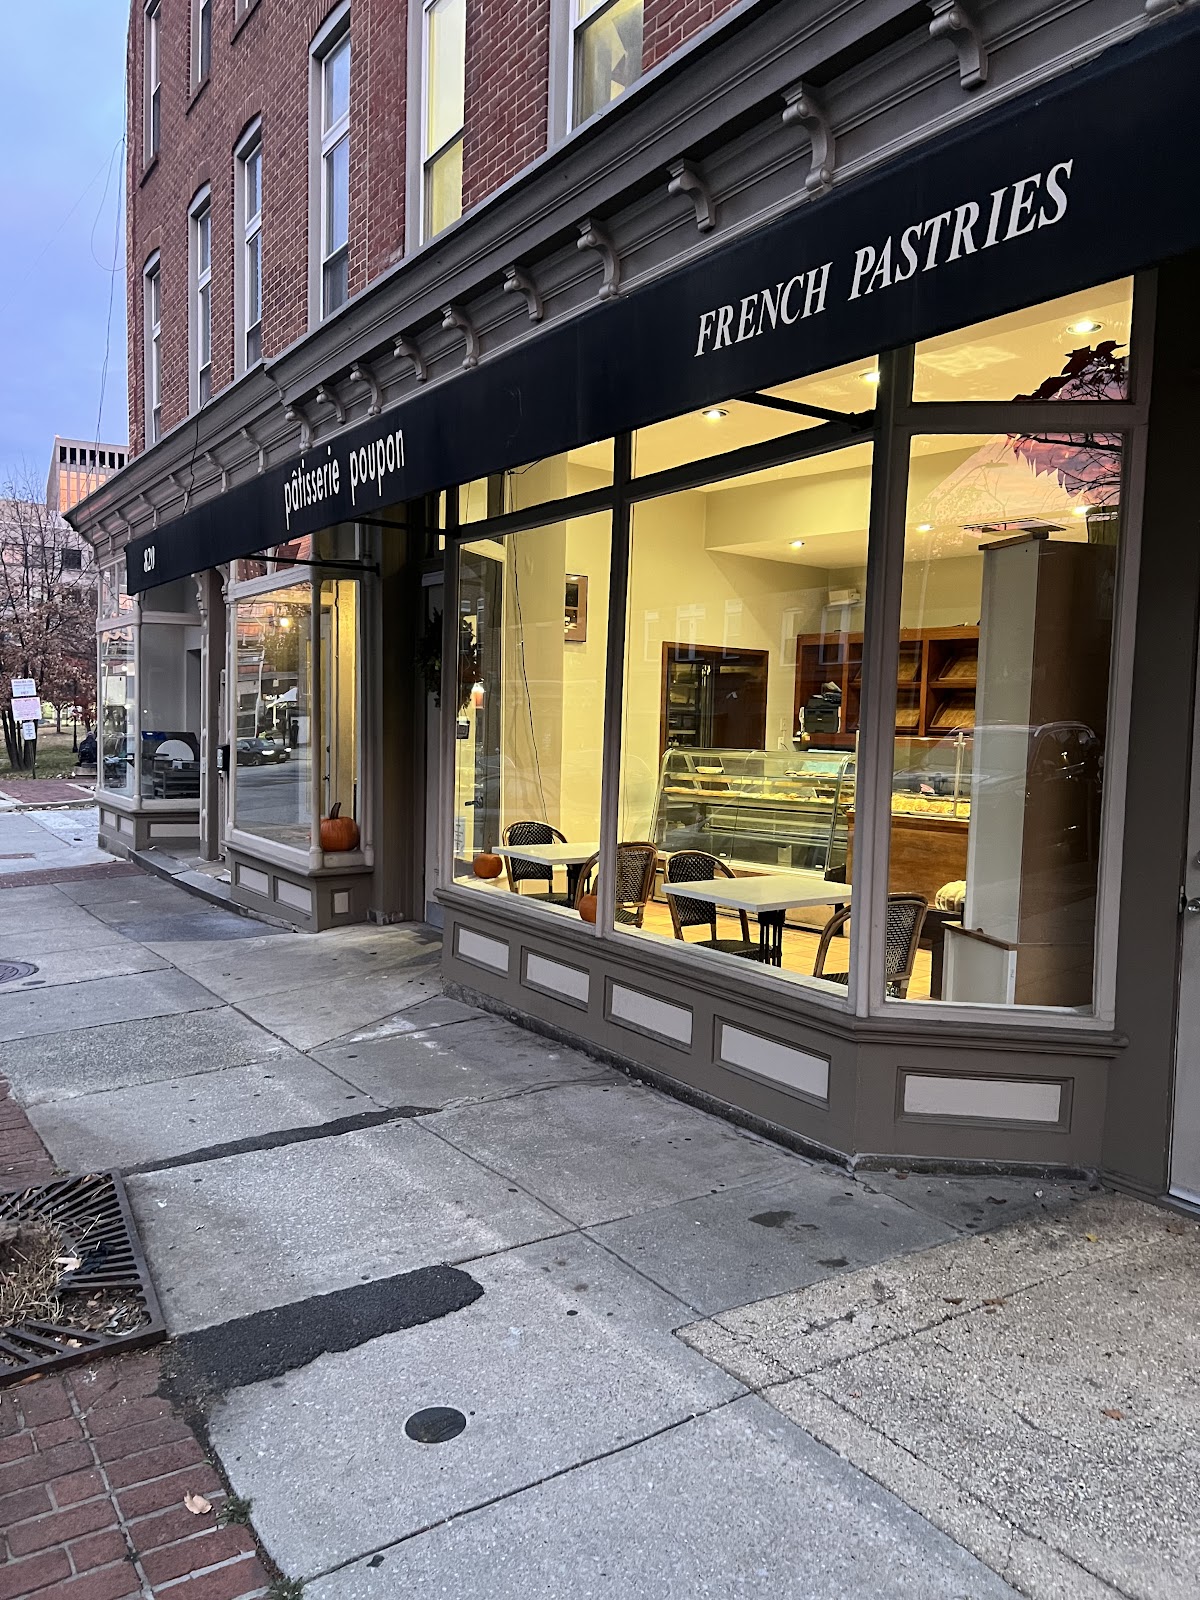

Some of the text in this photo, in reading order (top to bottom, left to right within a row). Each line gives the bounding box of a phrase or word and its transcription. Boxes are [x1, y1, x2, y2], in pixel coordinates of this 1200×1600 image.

[694, 158, 1075, 358] FRENCH PASTRIES
[283, 429, 405, 530] pâtisserie poupon
[143, 545, 156, 573] 820
